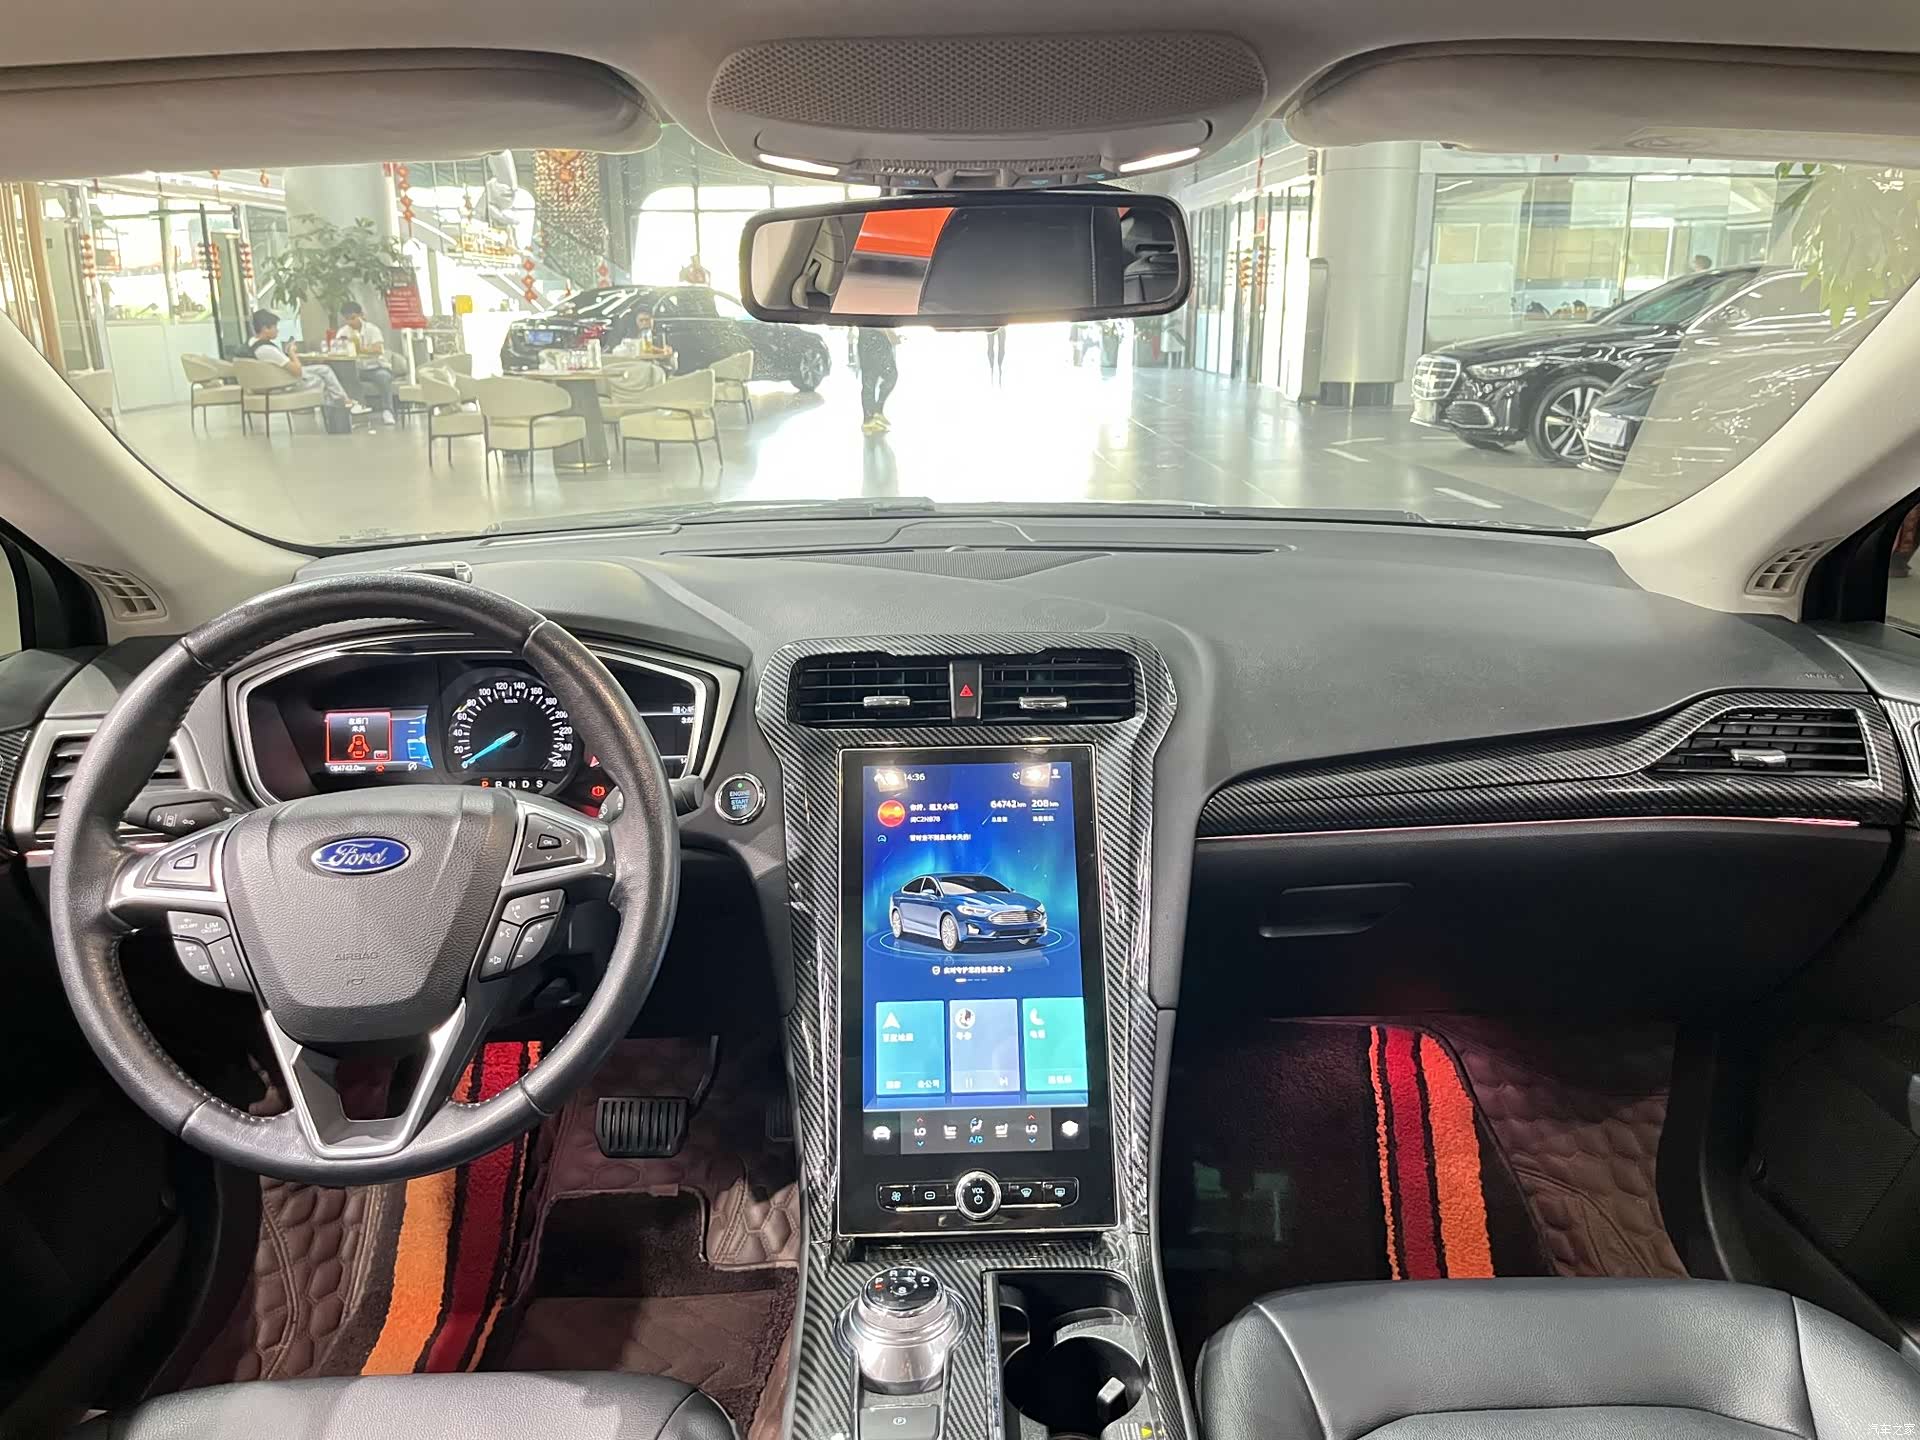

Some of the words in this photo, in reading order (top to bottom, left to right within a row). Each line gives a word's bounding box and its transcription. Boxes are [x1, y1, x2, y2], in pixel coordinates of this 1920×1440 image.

[495, 682, 508, 690] 120
[513, 682, 526, 690] 140
[479, 688, 491, 696] 100
[530, 687, 542, 695] 160
[467, 699, 477, 707] 80
[545, 697, 558, 705] 180
[555, 711, 568, 719] 200
[453, 729, 463, 737] 40
[559, 727, 573, 735] 220
[454, 746, 464, 754] 20
[559, 743, 572, 751] 240
[552, 759, 566, 767] 260
[536, 780, 544, 788] S
[318, 842, 388, 867] Ford
[334, 951, 379, 961] AIRBAG
[914, 1127, 927, 1136] LO
[1025, 1124, 1038, 1133] LO
[969, 1136, 983, 1144] A/C
